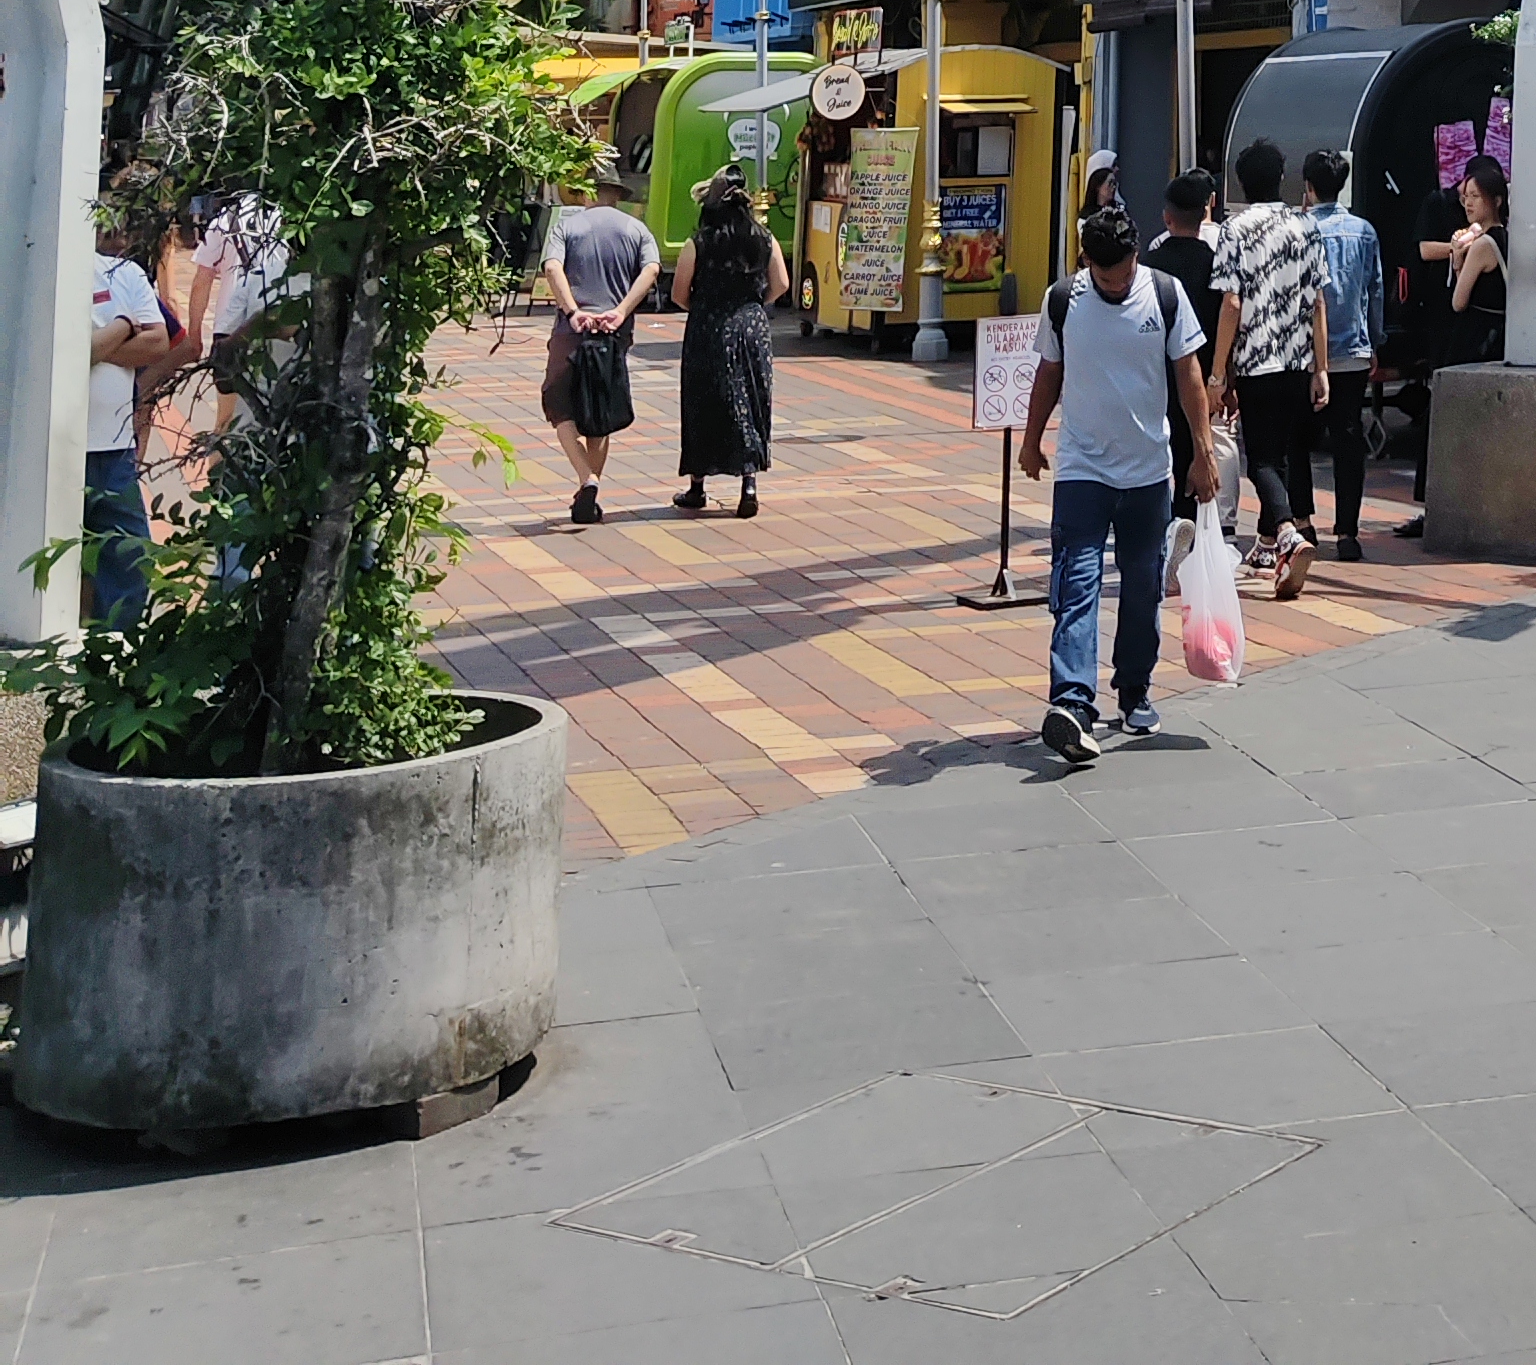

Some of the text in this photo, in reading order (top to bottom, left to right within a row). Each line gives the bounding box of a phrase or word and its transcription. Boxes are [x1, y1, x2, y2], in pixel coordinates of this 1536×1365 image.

[824, 73, 851, 89] Bread
[826, 98, 852, 113] Juice
[882, 173, 908, 182] JUICE
[850, 188, 911, 196] ORANGE JUICE
[943, 195, 997, 206] BUY 3 JUICES
[850, 202, 908, 210] MANGO JUICE
[847, 216, 907, 225] DRAGON FRUIT
[863, 230, 888, 239] JUICE
[848, 245, 904, 253] WATERMELON
[862, 259, 886, 267] JUICE
[844, 273, 902, 282] CARROT JUICE
[850, 288, 894, 296] LIME JUICE
[986, 322, 1036, 333] KENDERAAN
[986, 332, 1036, 344] DILARANG
[994, 342, 1027, 354] MASUK
